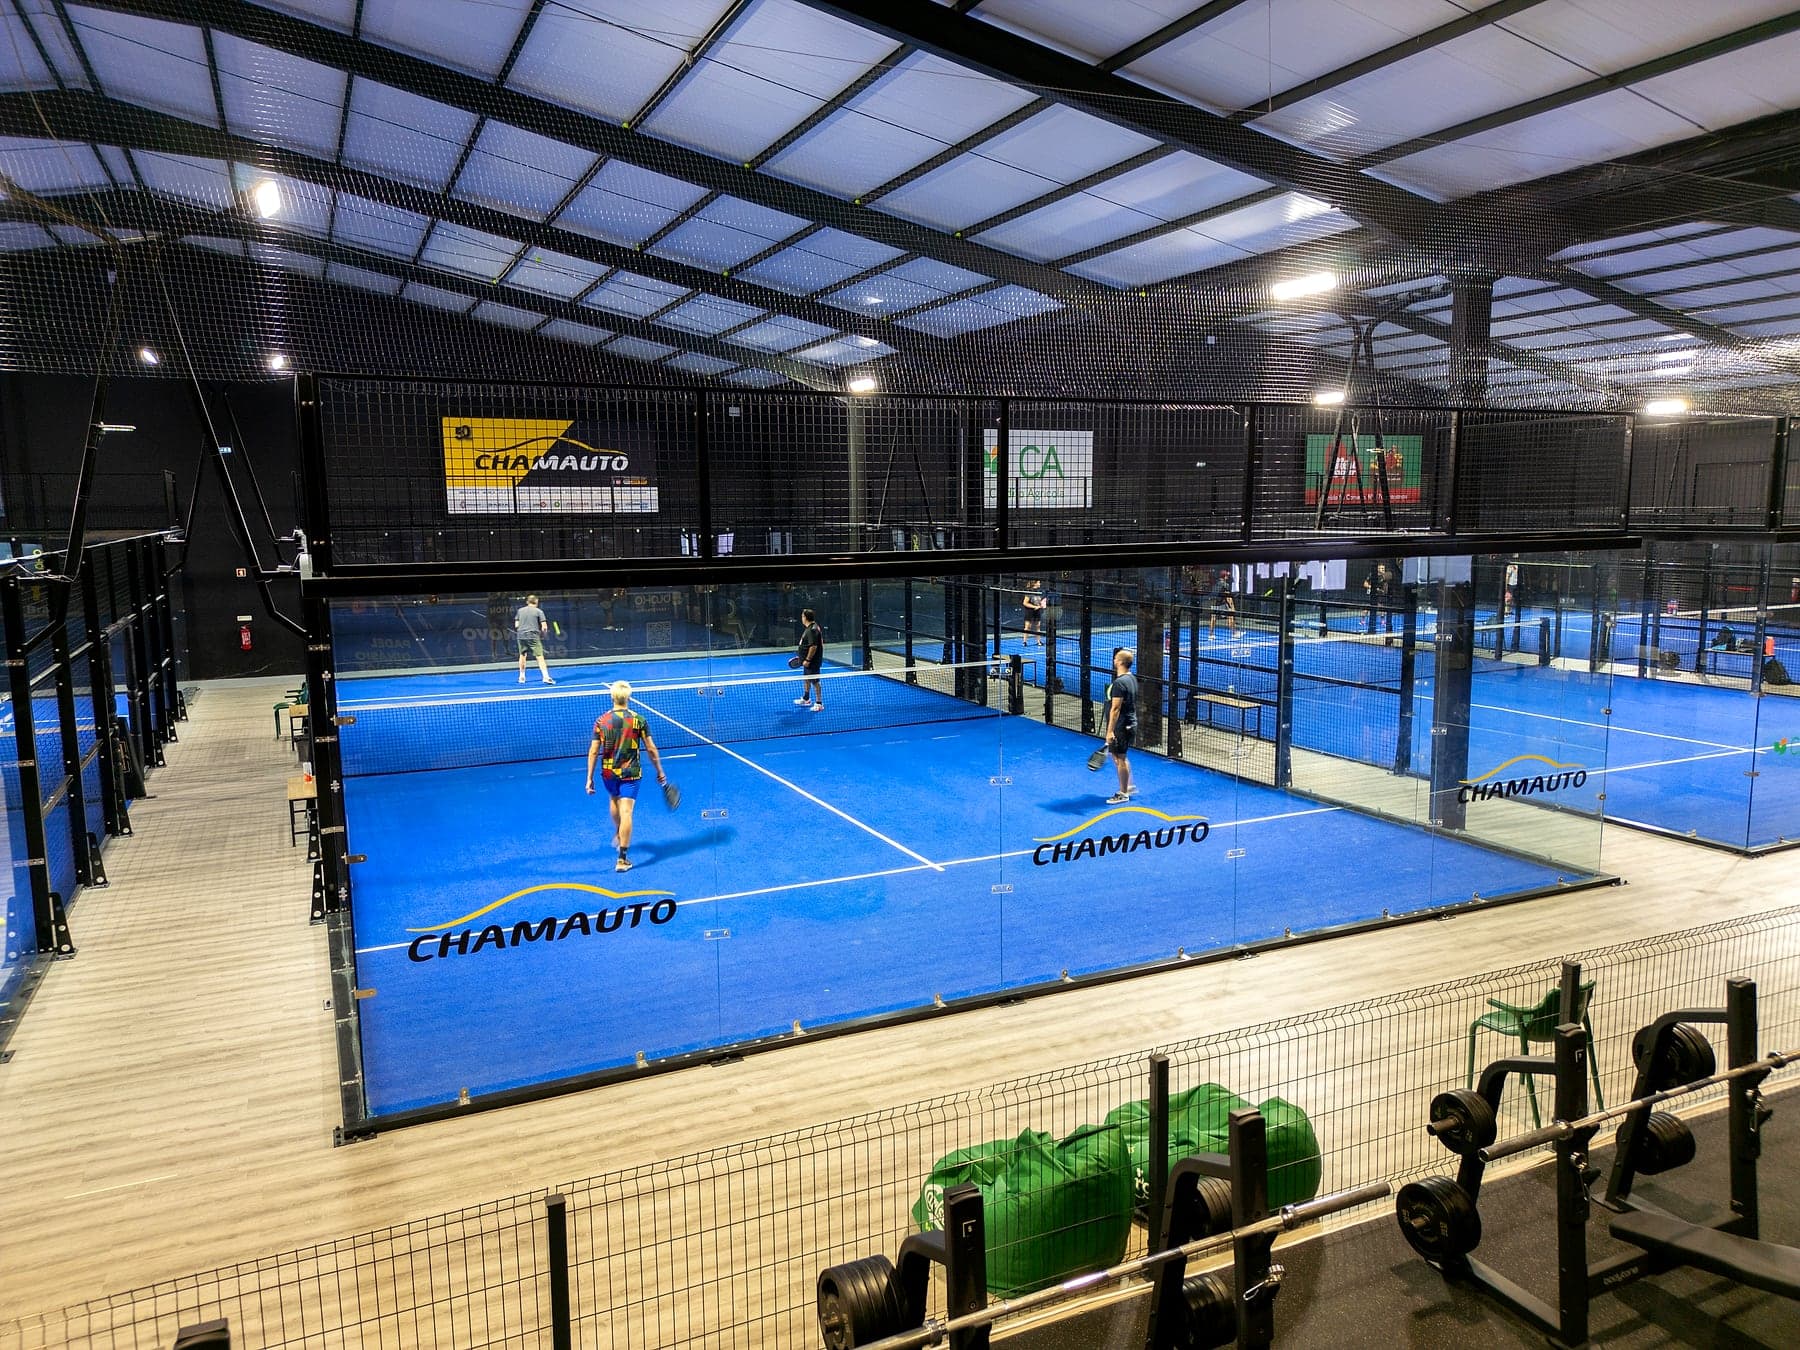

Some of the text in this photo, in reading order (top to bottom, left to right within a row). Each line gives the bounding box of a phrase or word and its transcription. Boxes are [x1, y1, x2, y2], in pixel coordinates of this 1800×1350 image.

[475, 454, 629, 471] CHAMAUTO
[1019, 444, 1064, 479] CA
[1457, 771, 1587, 804] CHAMAUTO
[1032, 821, 1210, 866] CHAMAUTO
[407, 898, 677, 963] CHAMAUTO
